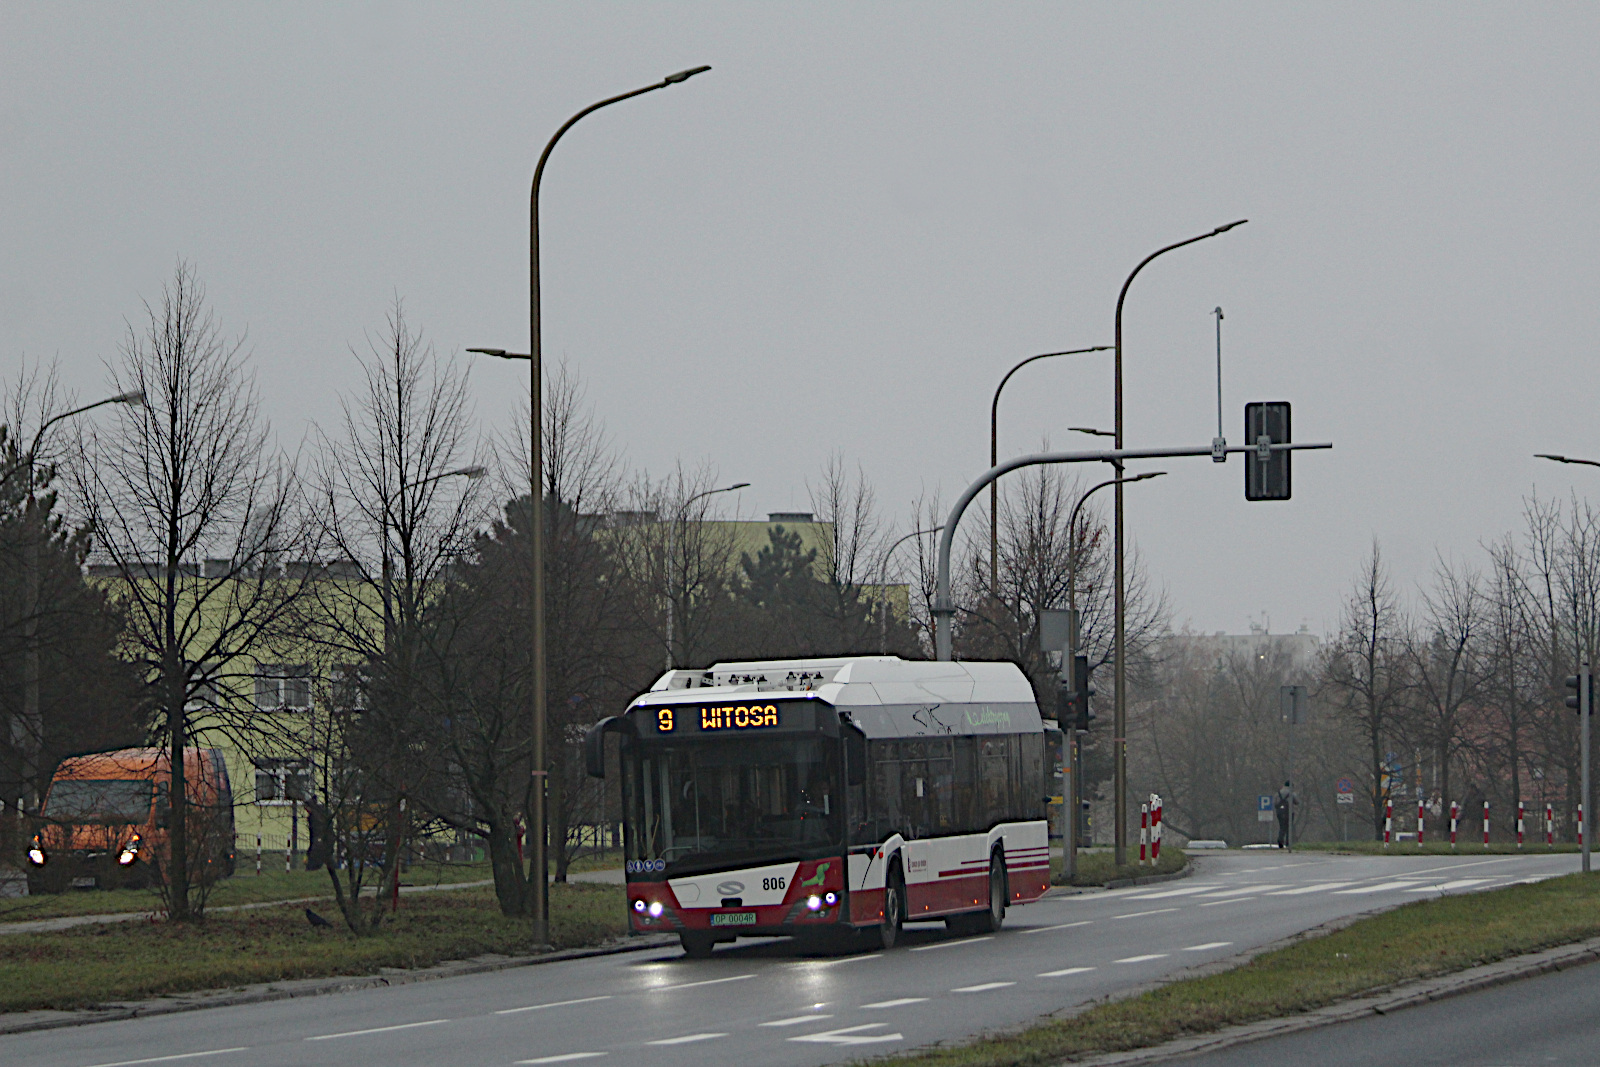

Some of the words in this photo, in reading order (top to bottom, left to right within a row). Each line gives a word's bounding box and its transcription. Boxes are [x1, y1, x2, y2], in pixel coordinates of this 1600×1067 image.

[658, 709, 673, 731] 9
[701, 705, 778, 729] WITOSA
[1260, 796, 1270, 809] P
[763, 877, 785, 890] 806
[715, 914, 726, 923] OP
[728, 913, 754, 923] 0004R
